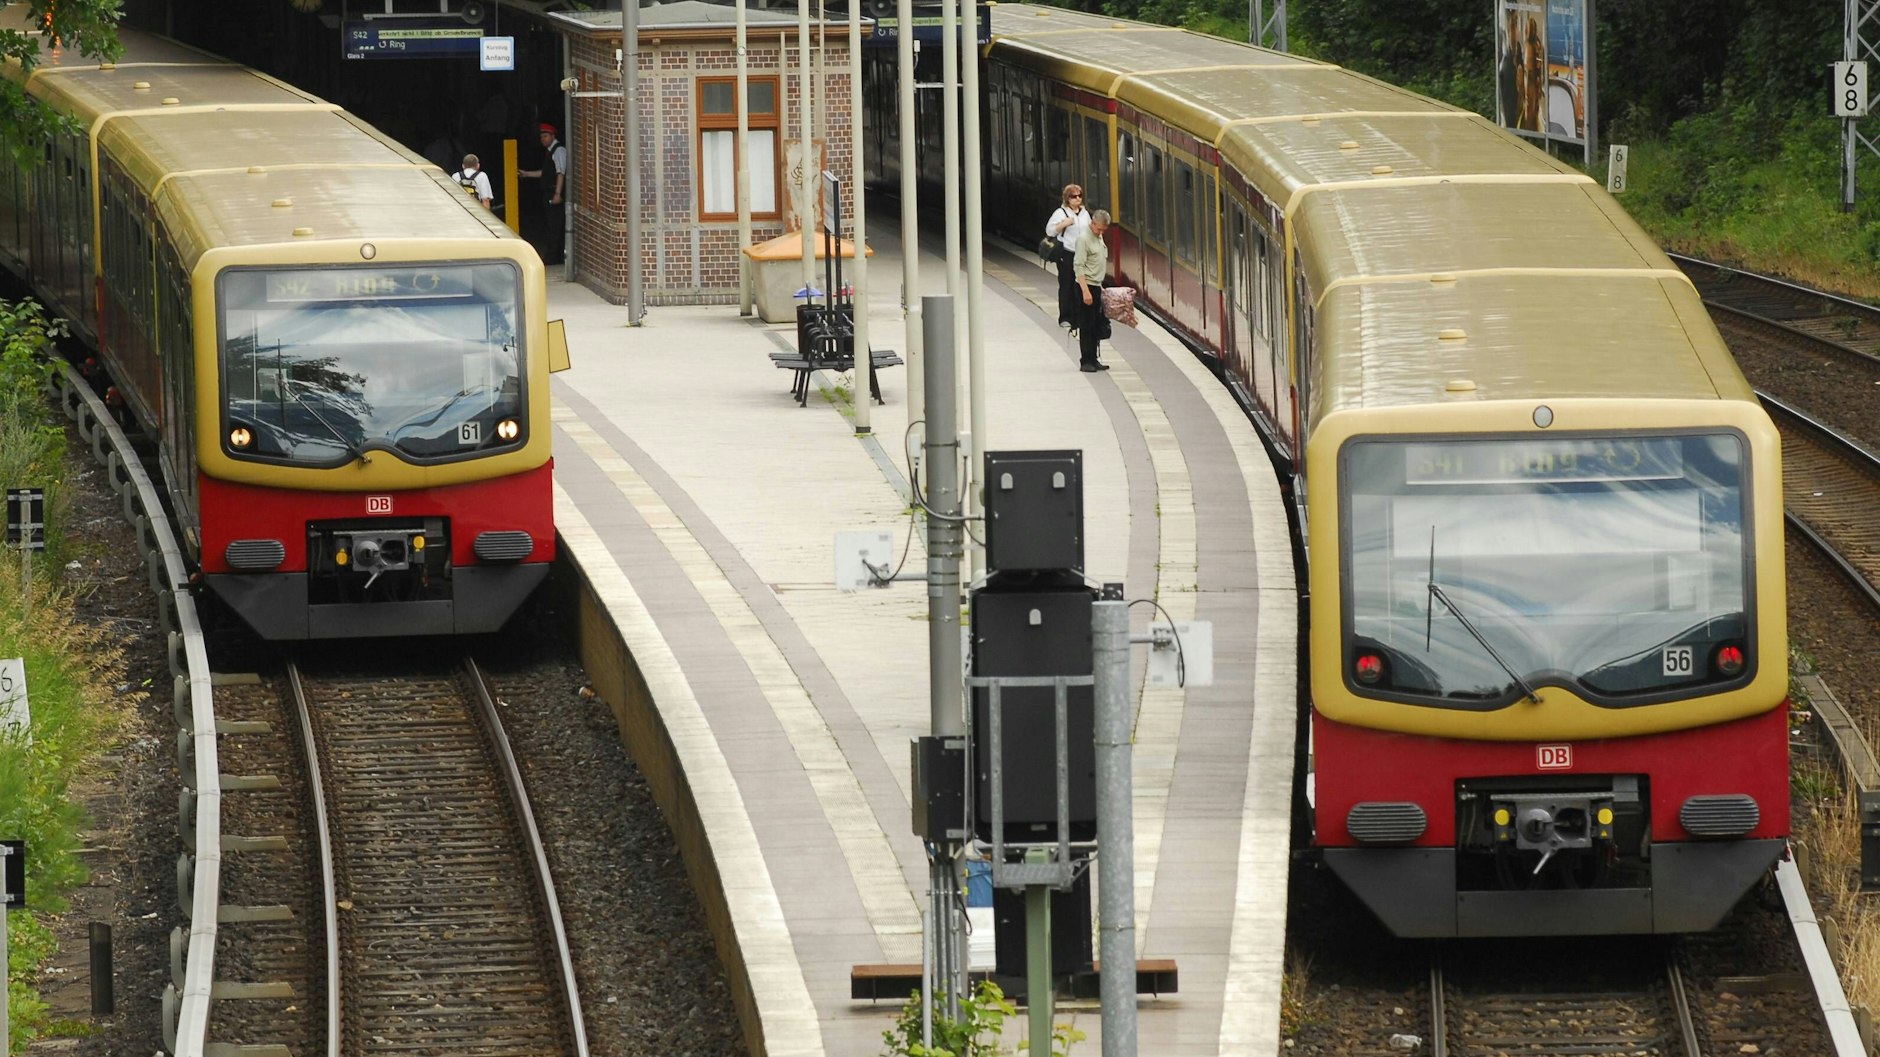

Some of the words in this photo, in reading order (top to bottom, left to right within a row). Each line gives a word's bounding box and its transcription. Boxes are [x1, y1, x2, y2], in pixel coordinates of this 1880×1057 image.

[353, 31, 368, 39] S42
[390, 41, 405, 50] Ring
[1845, 64, 1858, 86] 6
[1845, 90, 1858, 110] 8
[1616, 148, 1622, 161] 6
[1614, 176, 1621, 189] 8
[462, 424, 478, 440] 61
[370, 498, 389, 510] DB
[1666, 650, 1690, 671] 56
[2, 666, 12, 692] 6
[1542, 748, 1567, 764] DB
